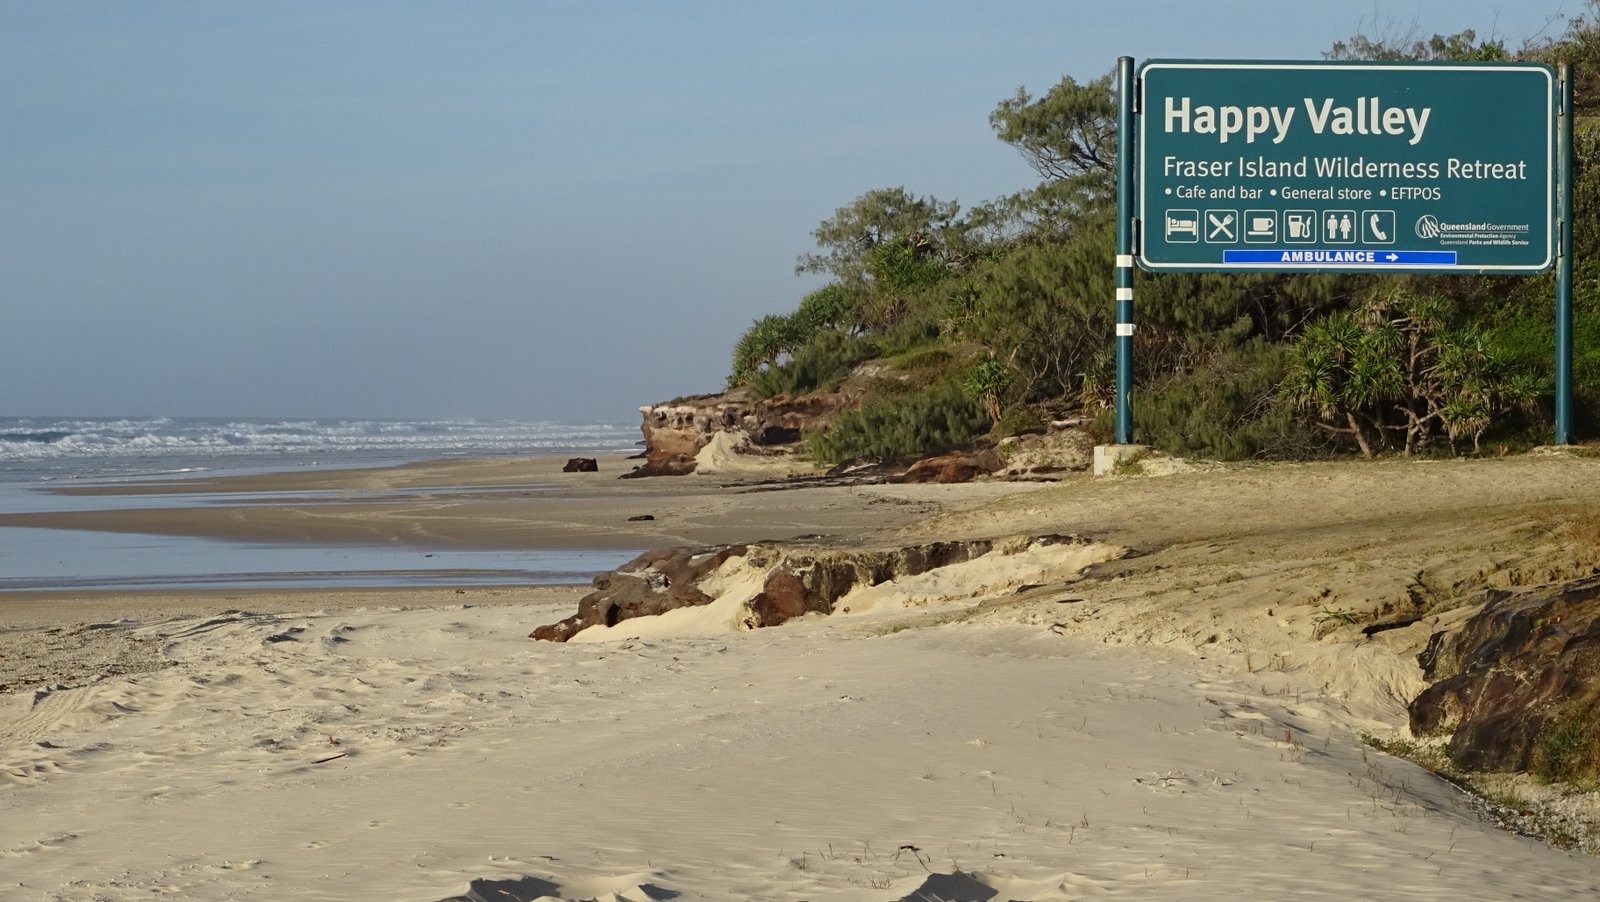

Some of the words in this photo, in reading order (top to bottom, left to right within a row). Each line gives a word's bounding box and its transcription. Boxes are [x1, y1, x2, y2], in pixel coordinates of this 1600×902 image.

[1164, 96, 1296, 144] Happy
[1304, 96, 1432, 146] Valley
[1164, 156, 1233, 177] Fraser
[1239, 156, 1307, 178] Island
[1315, 156, 1440, 179] Wilderness
[1447, 158, 1527, 180] Retreat
[1176, 185, 1207, 199] Cafe
[1210, 185, 1236, 199] and
[1240, 185, 1263, 200] bar
[1281, 186, 1334, 200] General
[1338, 187, 1372, 200] store
[1391, 187, 1441, 201] EFTPOS
[1440, 222, 1486, 232] Queensland
[1487, 223, 1529, 231] Government
[1281, 251, 1375, 263] AMBULANCE
